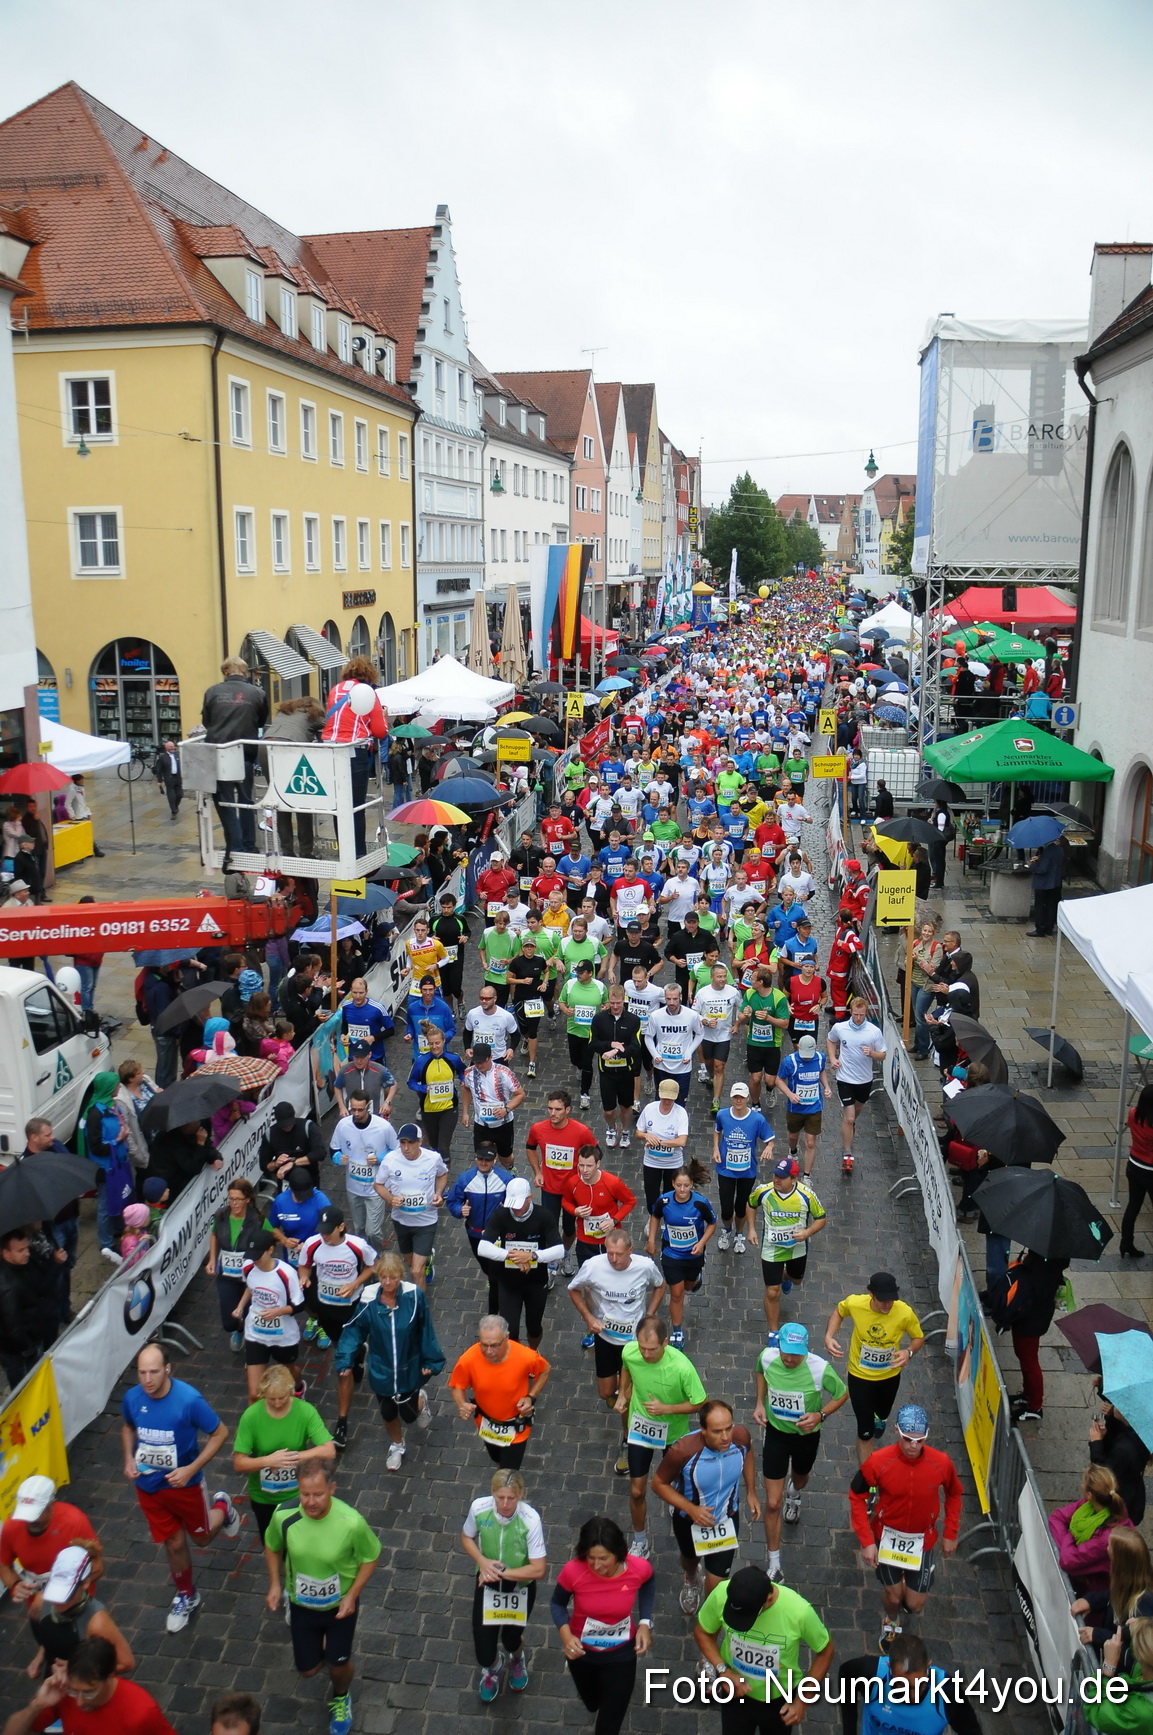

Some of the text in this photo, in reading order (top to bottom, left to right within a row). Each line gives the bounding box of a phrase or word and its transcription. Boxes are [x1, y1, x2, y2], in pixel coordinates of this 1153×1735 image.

[689, 507, 698, 551] HOTEL
[1008, 532, 1082, 544] www.barow
[570, 700, 580, 712] A
[823, 717, 833, 729] A
[813, 761, 844, 769] Schnupper-
[996, 758, 1063, 767] Lammsbräu
[879, 885, 915, 897] Jugend-
[887, 894, 905, 904] lauf
[0, 917, 190, 942] Serviceline: 09181 6352
[628, 996, 651, 1006] THULE
[528, 1003, 541, 1011] 318
[709, 1006, 723, 1014] 254
[576, 1009, 594, 1018] 2836
[350, 1029, 368, 1038] 2720
[660, 1025, 688, 1034] THULE
[475, 1036, 494, 1044] 2185
[663, 1046, 681, 1054] 2423
[434, 1085, 450, 1094] 586
[798, 1088, 818, 1098] 2777
[550, 1150, 568, 1161] 324
[728, 1152, 749, 1163] 3075
[350, 1165, 373, 1177] 2498
[402, 1196, 425, 1208] 2982
[671, 1230, 695, 1240] 3099
[160, 1222, 193, 1275] BMW
[224, 1257, 244, 1268] 213
[604, 1290, 628, 1298] Allianz
[254, 1315, 280, 1328] 2920
[604, 1322, 633, 1334] 3098
[863, 1351, 892, 1363] 2582
[771, 1395, 800, 1411] 2831
[138, 1427, 175, 1438] HUBER
[633, 1421, 663, 1438] 2561
[139, 1453, 174, 1467] 2758
[700, 1525, 727, 1540] 516
[889, 1537, 915, 1555] 182
[891, 1552, 908, 1563] Heiko
[300, 1582, 337, 1597] 2548
[493, 1594, 519, 1609] 519
[492, 1611, 517, 1620] Susanne
[735, 1647, 775, 1668] 2028
